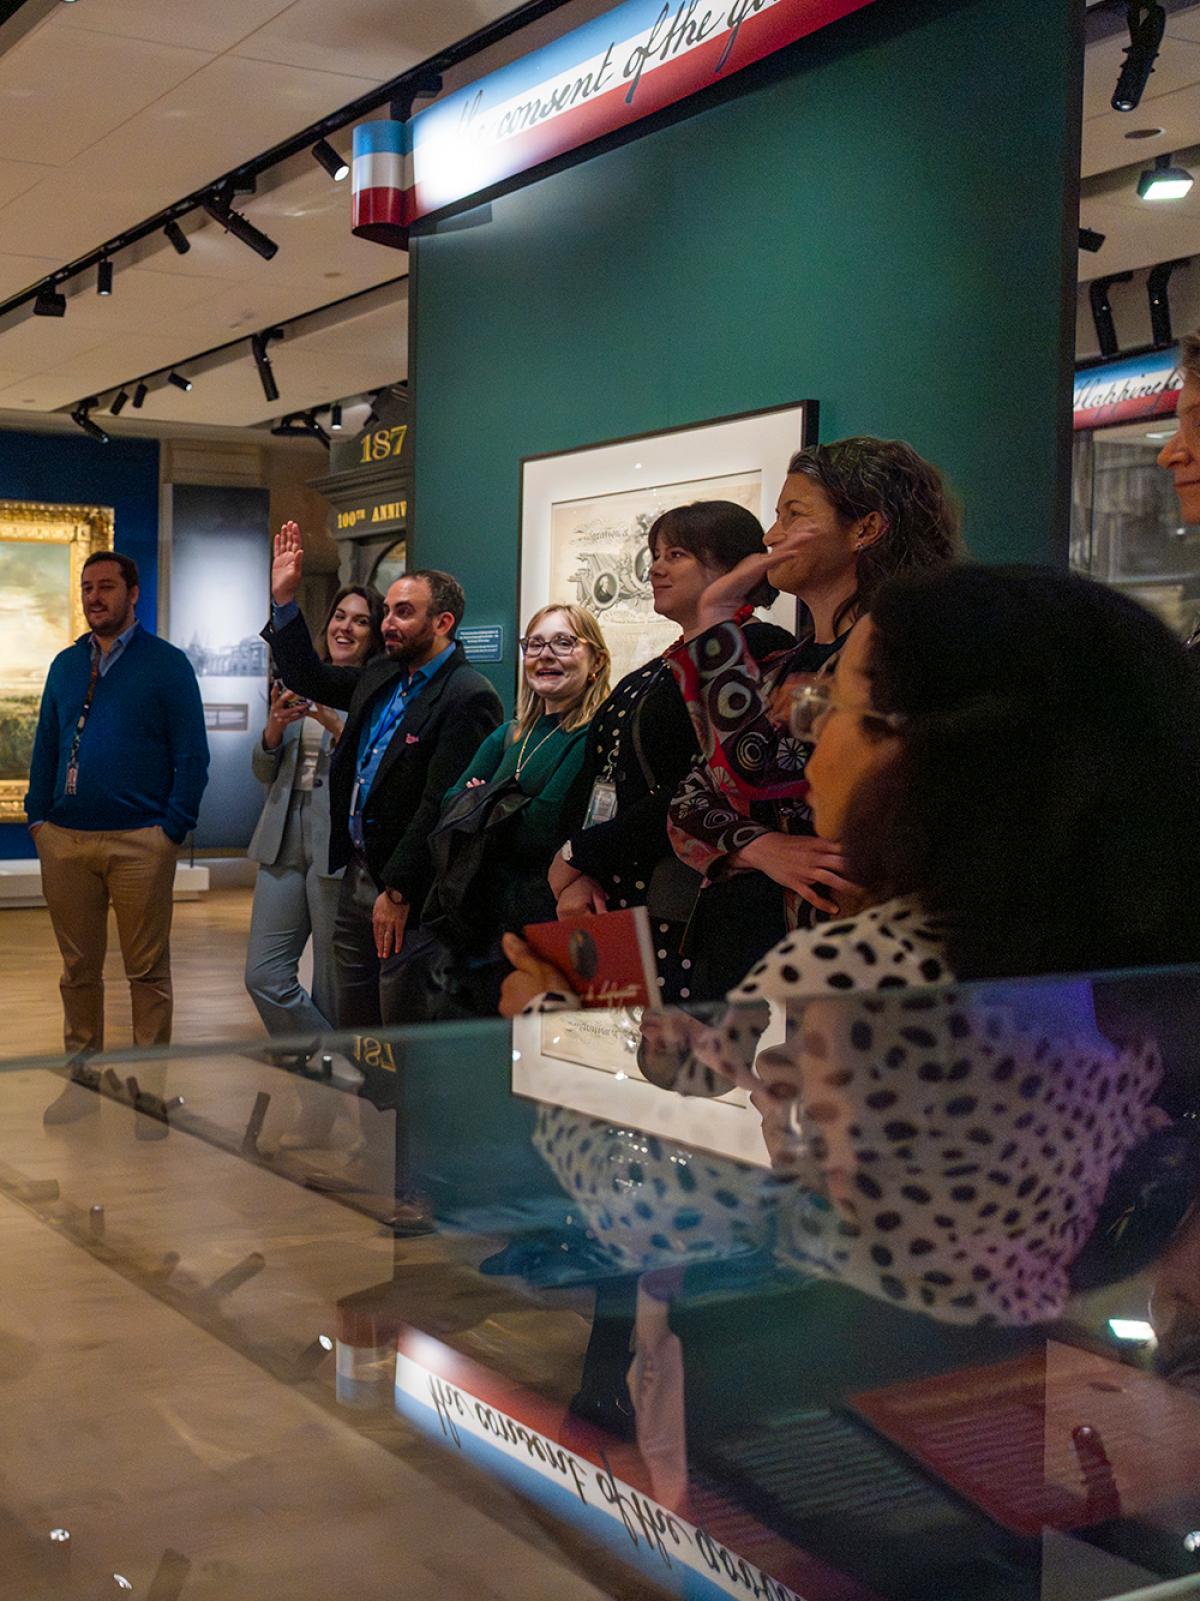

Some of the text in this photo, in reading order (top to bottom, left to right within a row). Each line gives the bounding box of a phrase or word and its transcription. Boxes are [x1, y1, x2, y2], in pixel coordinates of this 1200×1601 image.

[497, 42, 615, 138] consent
[623, 1, 670, 103] of
[360, 426, 407, 463] 187
